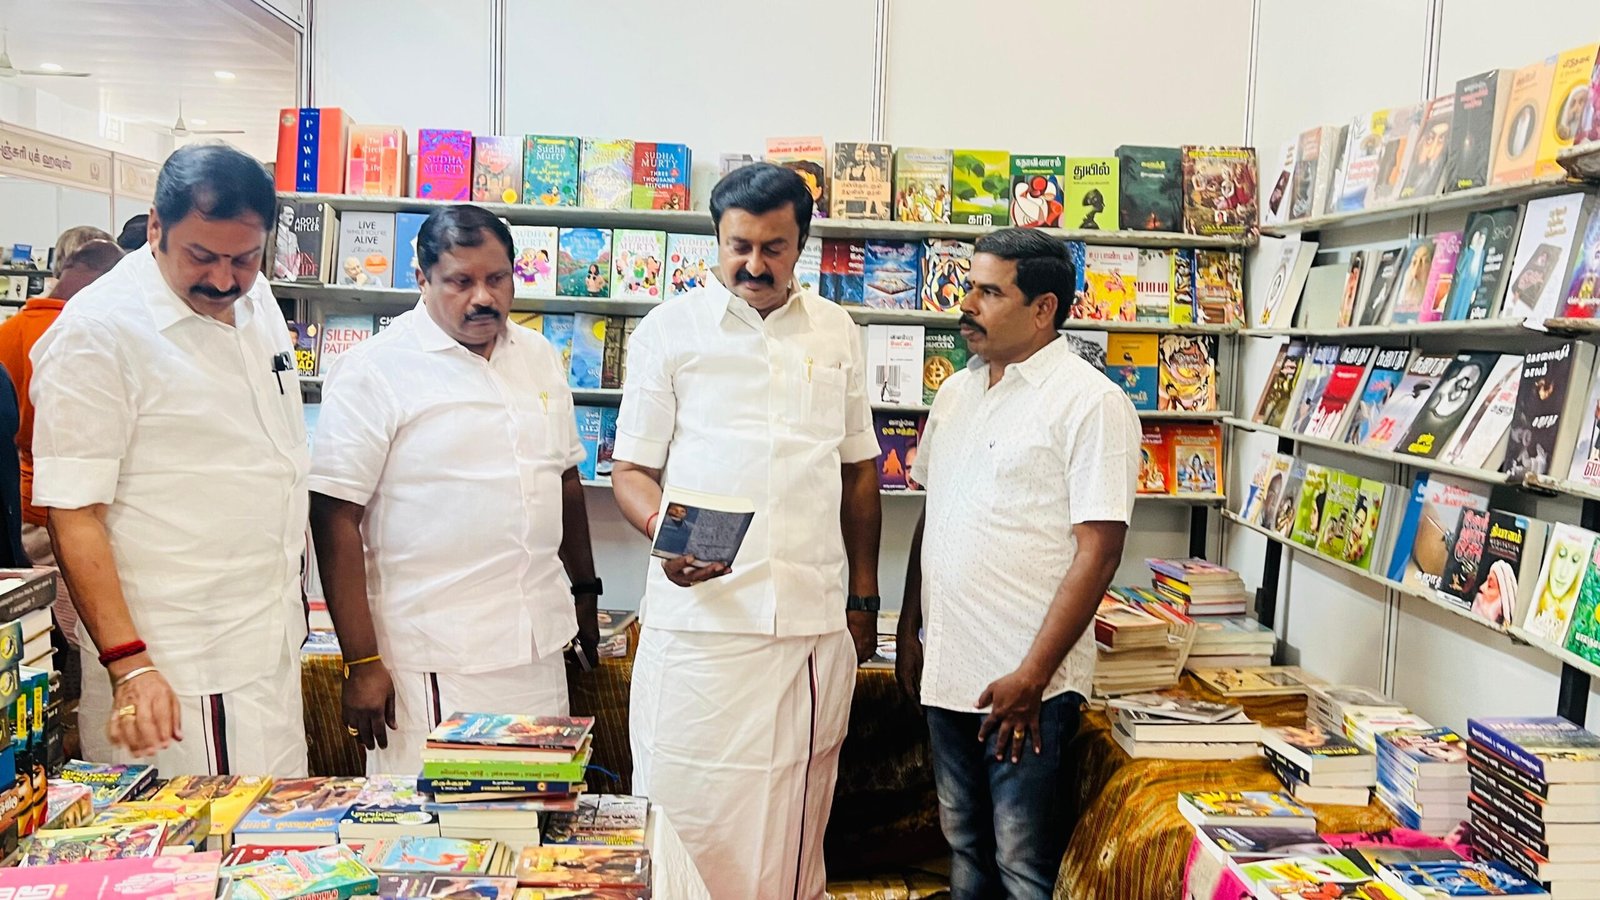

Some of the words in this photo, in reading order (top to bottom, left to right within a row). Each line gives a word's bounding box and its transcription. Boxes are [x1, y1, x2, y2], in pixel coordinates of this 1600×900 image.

[303, 117, 315, 183] POWER
[537, 144, 566, 154] Sudha
[427, 155, 462, 165] SUDHA
[536, 152, 566, 162] Murty
[645, 151, 675, 160] SUDHA
[641, 159, 678, 169] MURTY
[423, 164, 466, 175] MURTY
[1073, 161, 1110, 180] துயில்
[642, 176, 676, 184] THOUSAND
[295, 216, 320, 225] ADOLF
[967, 213, 992, 226] காடு
[294, 223, 320, 232] HITLER
[358, 221, 376, 229] LIVE
[515, 230, 547, 239] SUDHA
[623, 235, 655, 244] SUDHA
[354, 236, 378, 245] ALIVE
[513, 237, 551, 247] MURTY
[677, 238, 709, 247] SUDHA
[620, 242, 656, 252] MURTY
[674, 245, 711, 256] MURTY
[326, 329, 371, 341] SILENT
[323, 342, 353, 354] PATIE
[1526, 343, 1570, 364] கொலையுதிர்
[1524, 362, 1548, 378] காலம்
[431, 779, 472, 788] திருக்குறள்
